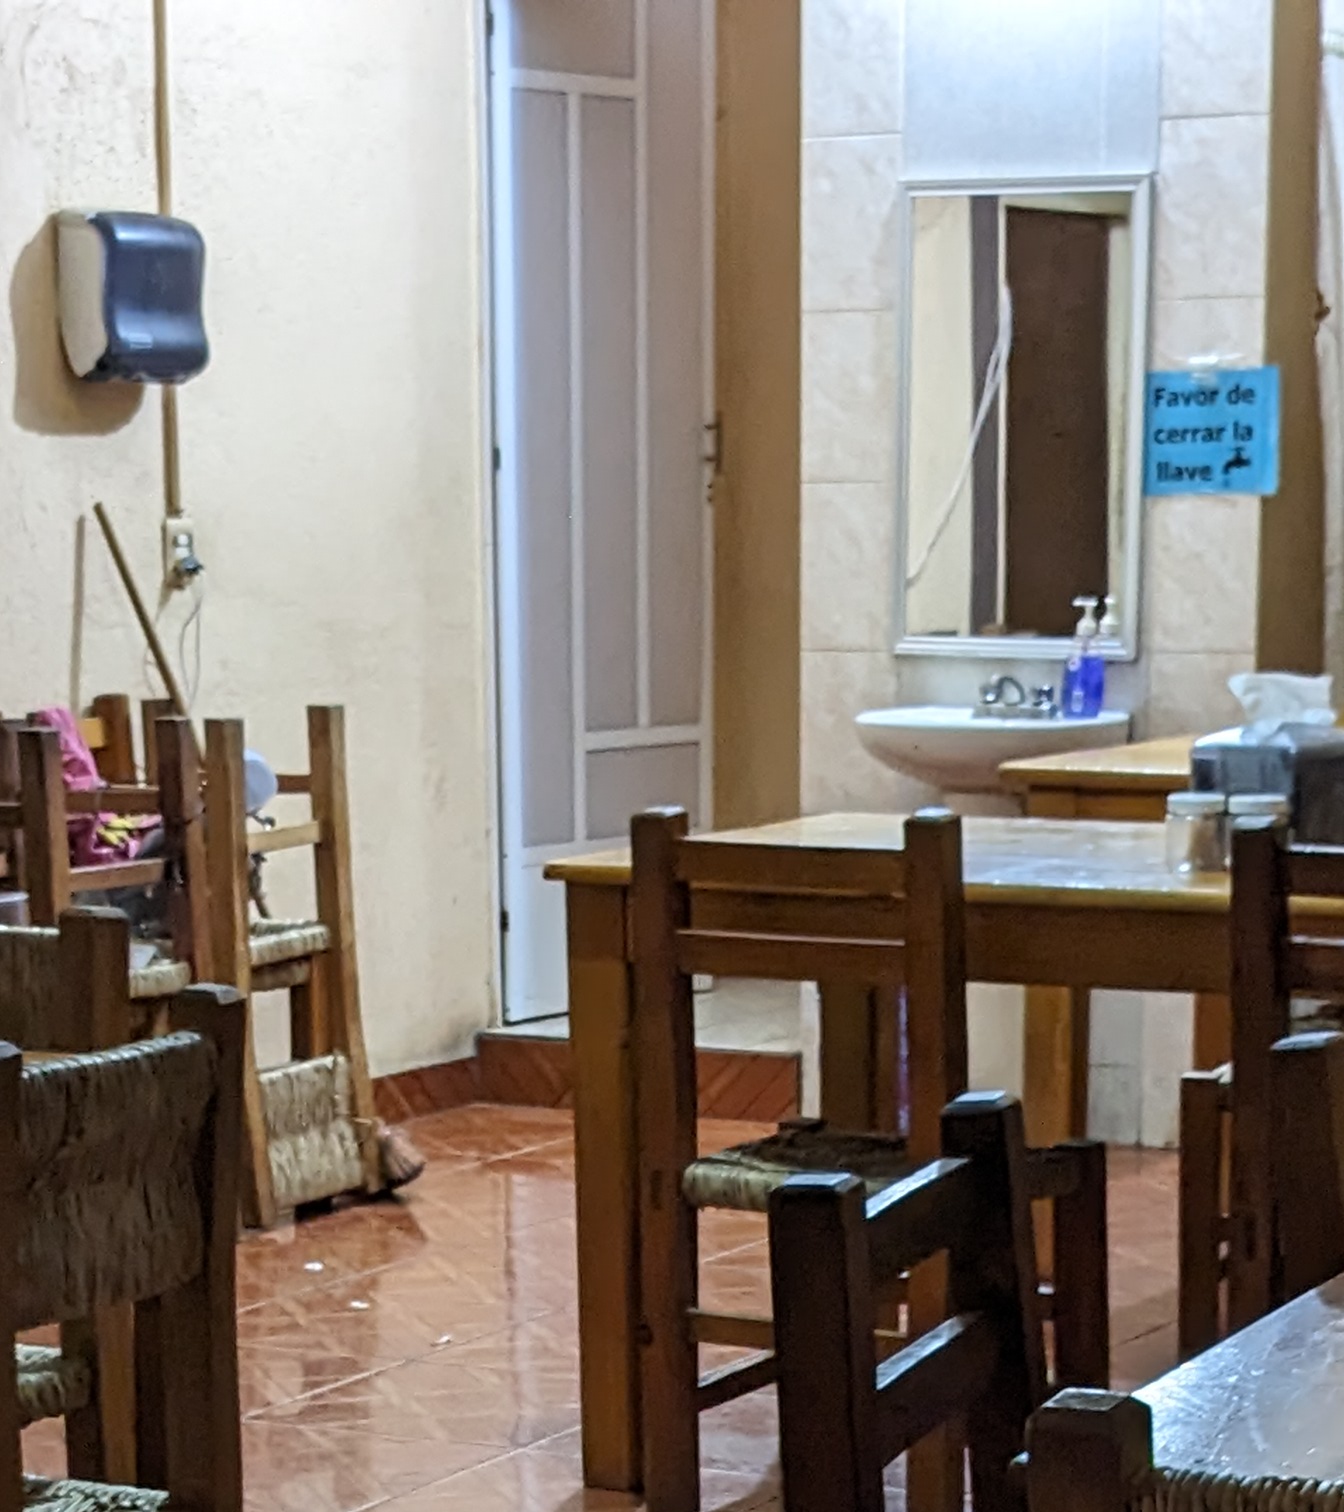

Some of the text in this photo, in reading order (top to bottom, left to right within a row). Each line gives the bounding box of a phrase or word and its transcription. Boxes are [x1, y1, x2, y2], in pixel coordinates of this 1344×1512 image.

[1153, 384, 1256, 408] Favor de
[1153, 421, 1254, 445] cerrar la
[1156, 461, 1213, 482] llave
